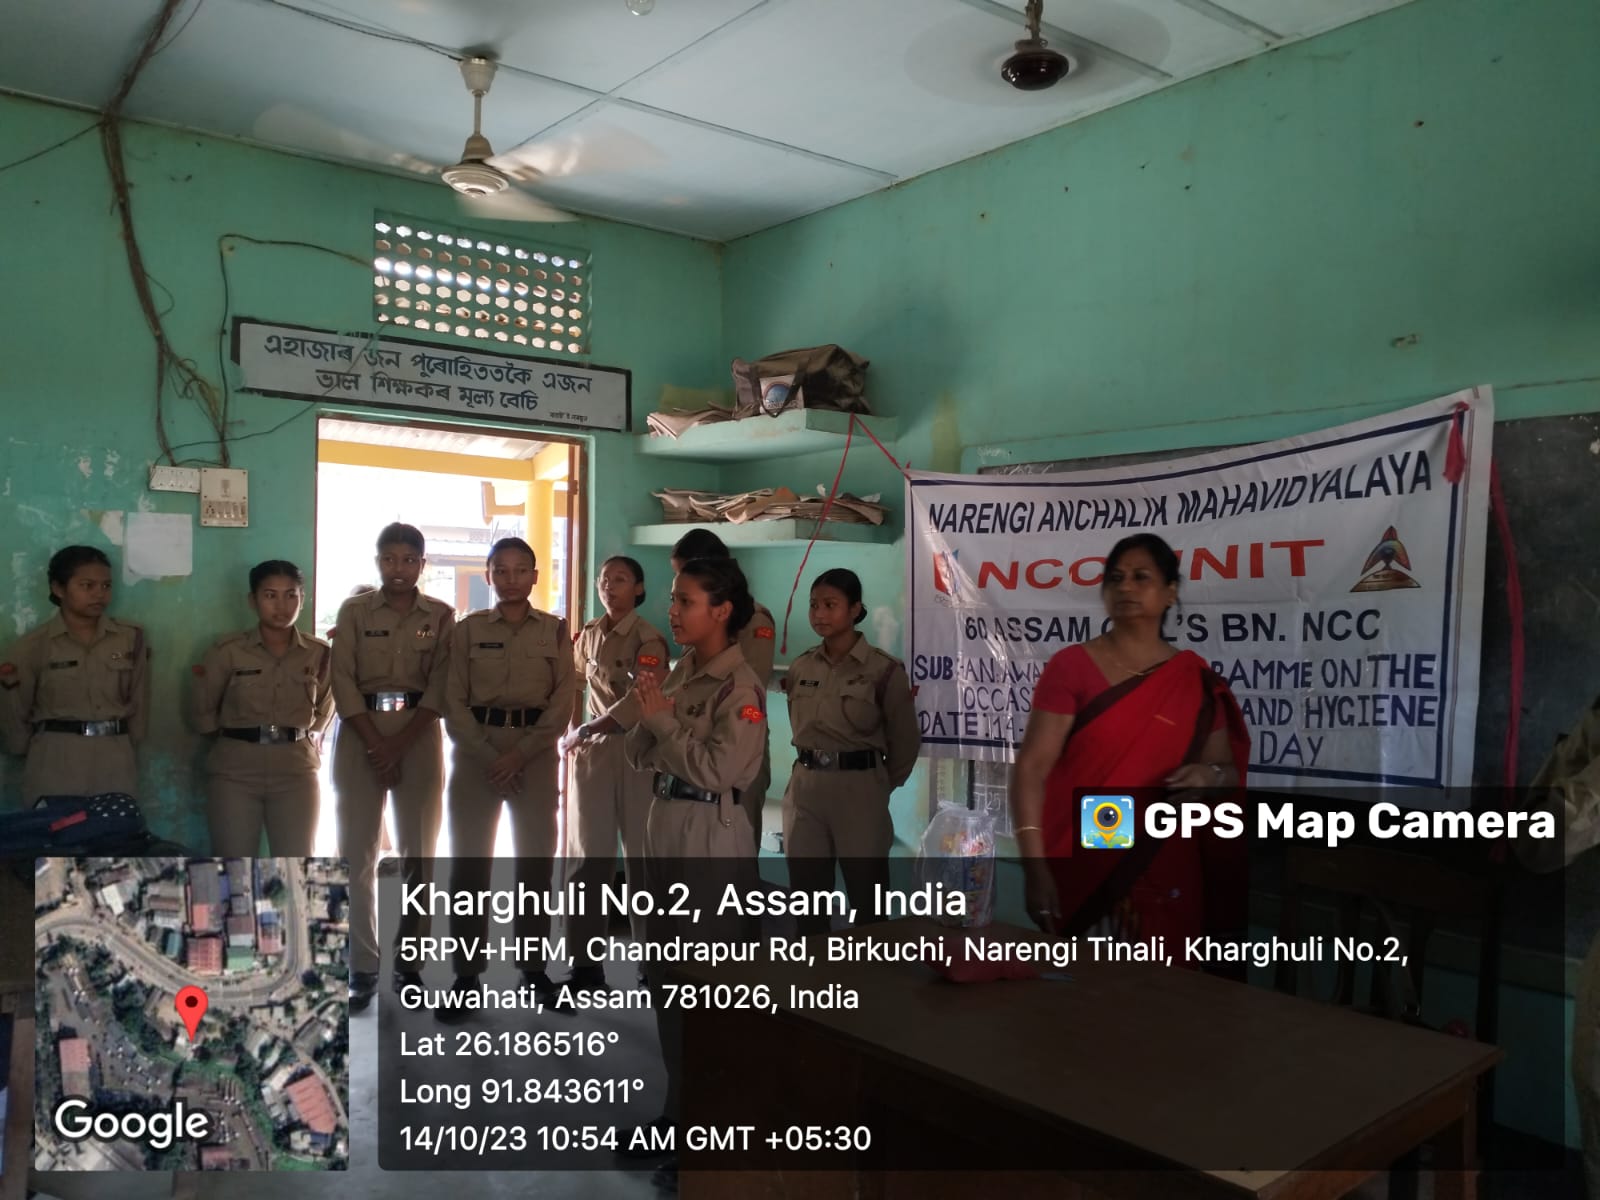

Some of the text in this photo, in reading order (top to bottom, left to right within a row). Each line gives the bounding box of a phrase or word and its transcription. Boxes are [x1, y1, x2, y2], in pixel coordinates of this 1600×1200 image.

[315, 368, 362, 391] ভাল
[499, 390, 540, 412] বেচি
[363, 347, 402, 369] জন
[541, 372, 593, 394] এজন
[929, 450, 1432, 534] NARENGI ANCHALIK MAHAVIDYALAYA
[1172, 538, 1325, 581] NIT
[964, 616, 988, 641] 60
[993, 616, 1091, 643] ASSAM
[1221, 612, 1286, 642] BN.
[1302, 608, 1381, 642] NCC
[1320, 658, 1362, 689] ON
[1366, 653, 1437, 690] THE
[963, 685, 1438, 729] OCCAS AND HYGIENE
[1259, 730, 1324, 766] DAY
